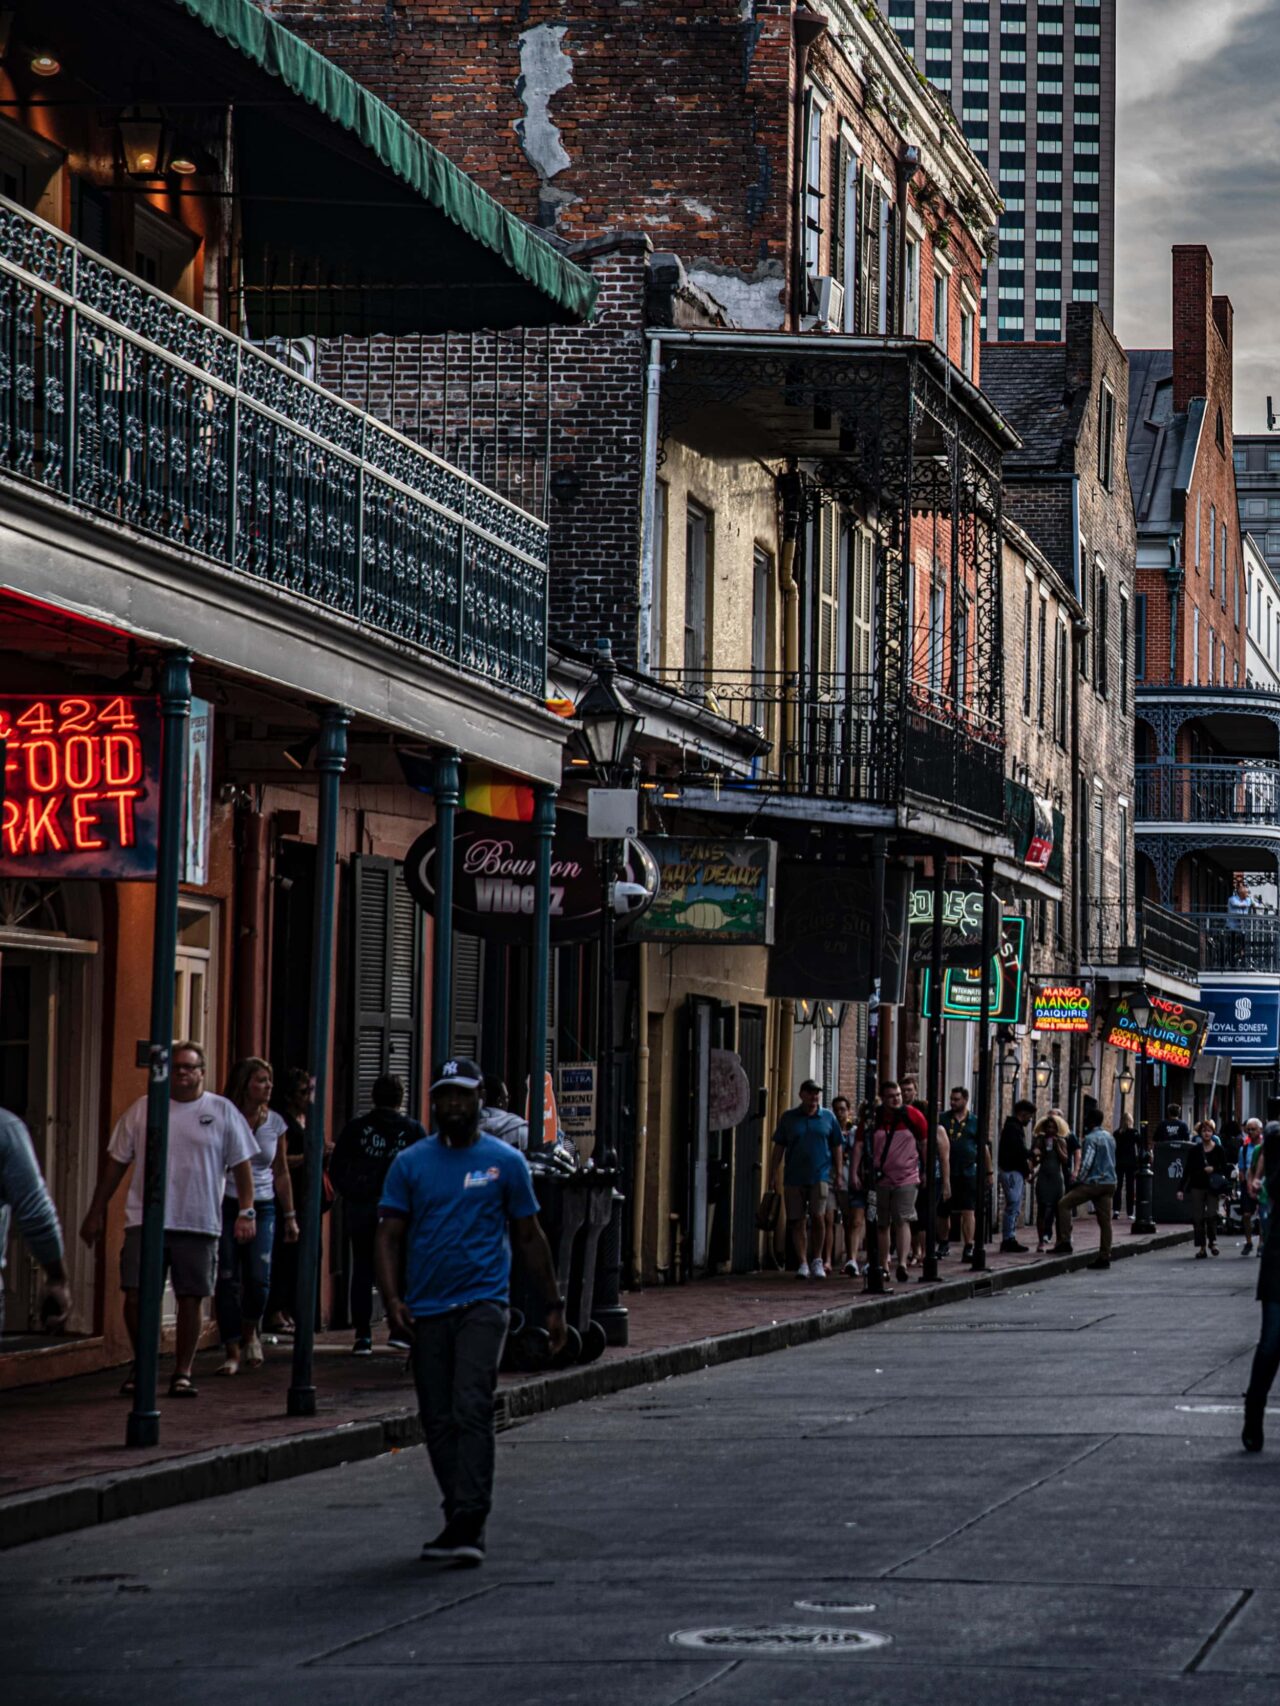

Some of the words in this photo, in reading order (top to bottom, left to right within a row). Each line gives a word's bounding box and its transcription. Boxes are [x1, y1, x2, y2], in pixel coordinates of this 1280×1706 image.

[16, 696, 137, 735] 424
[462, 838, 583, 878] Bouron
[1042, 987, 1082, 997] MANGO
[1034, 996, 1091, 1010] MANGO
[1036, 1009, 1088, 1018] DAIQUIRIS
[1119, 1016, 1189, 1047] DAUIRIS
[1238, 1023, 1268, 1032] SONESTA
[1108, 1033, 1131, 1049] PIZZA
[1217, 1035, 1233, 1043] NEW
[1234, 1035, 1262, 1043] ORLEANS
[1164, 1043, 1191, 1058] BEER
[563, 1075, 592, 1083] ULTRA
[562, 1094, 593, 1103] MENU
